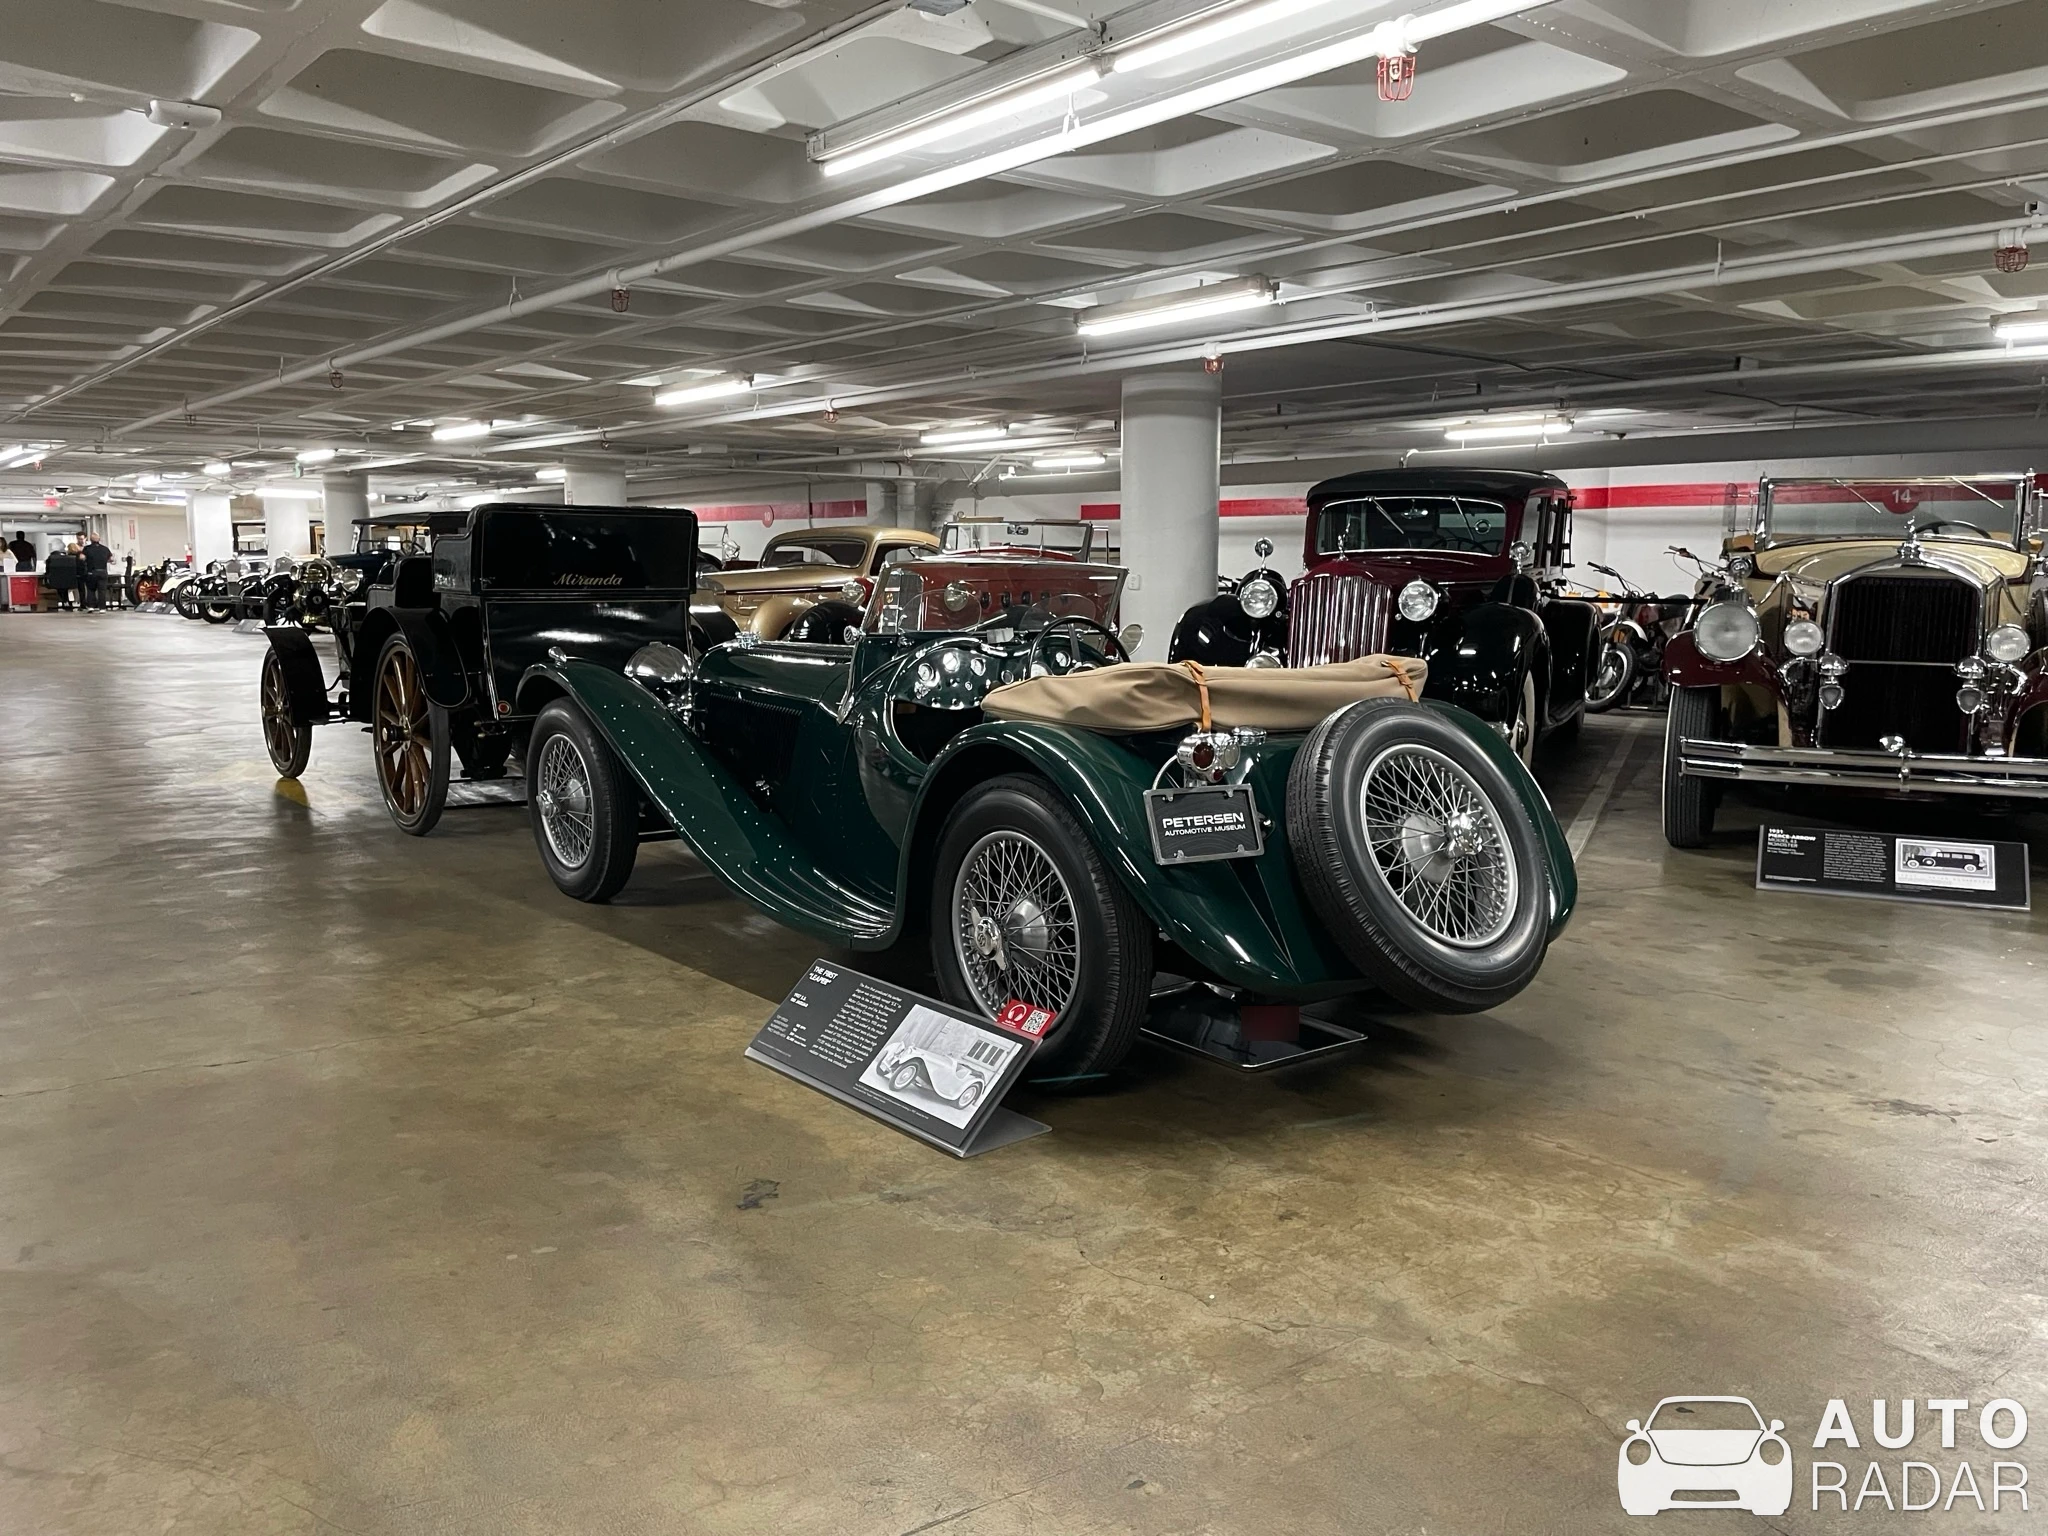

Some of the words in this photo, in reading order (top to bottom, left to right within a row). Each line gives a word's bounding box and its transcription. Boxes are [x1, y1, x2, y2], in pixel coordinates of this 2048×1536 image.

[1892, 489, 1911, 503] 14
[553, 573, 623, 585] Miranda
[1162, 812, 1244, 828] PETERSEN
[1164, 827, 1212, 836] AUTOMOTIVE
[1214, 824, 1246, 832] MUSEUM
[813, 965, 824, 976] THE
[823, 969, 839, 980] FIRST
